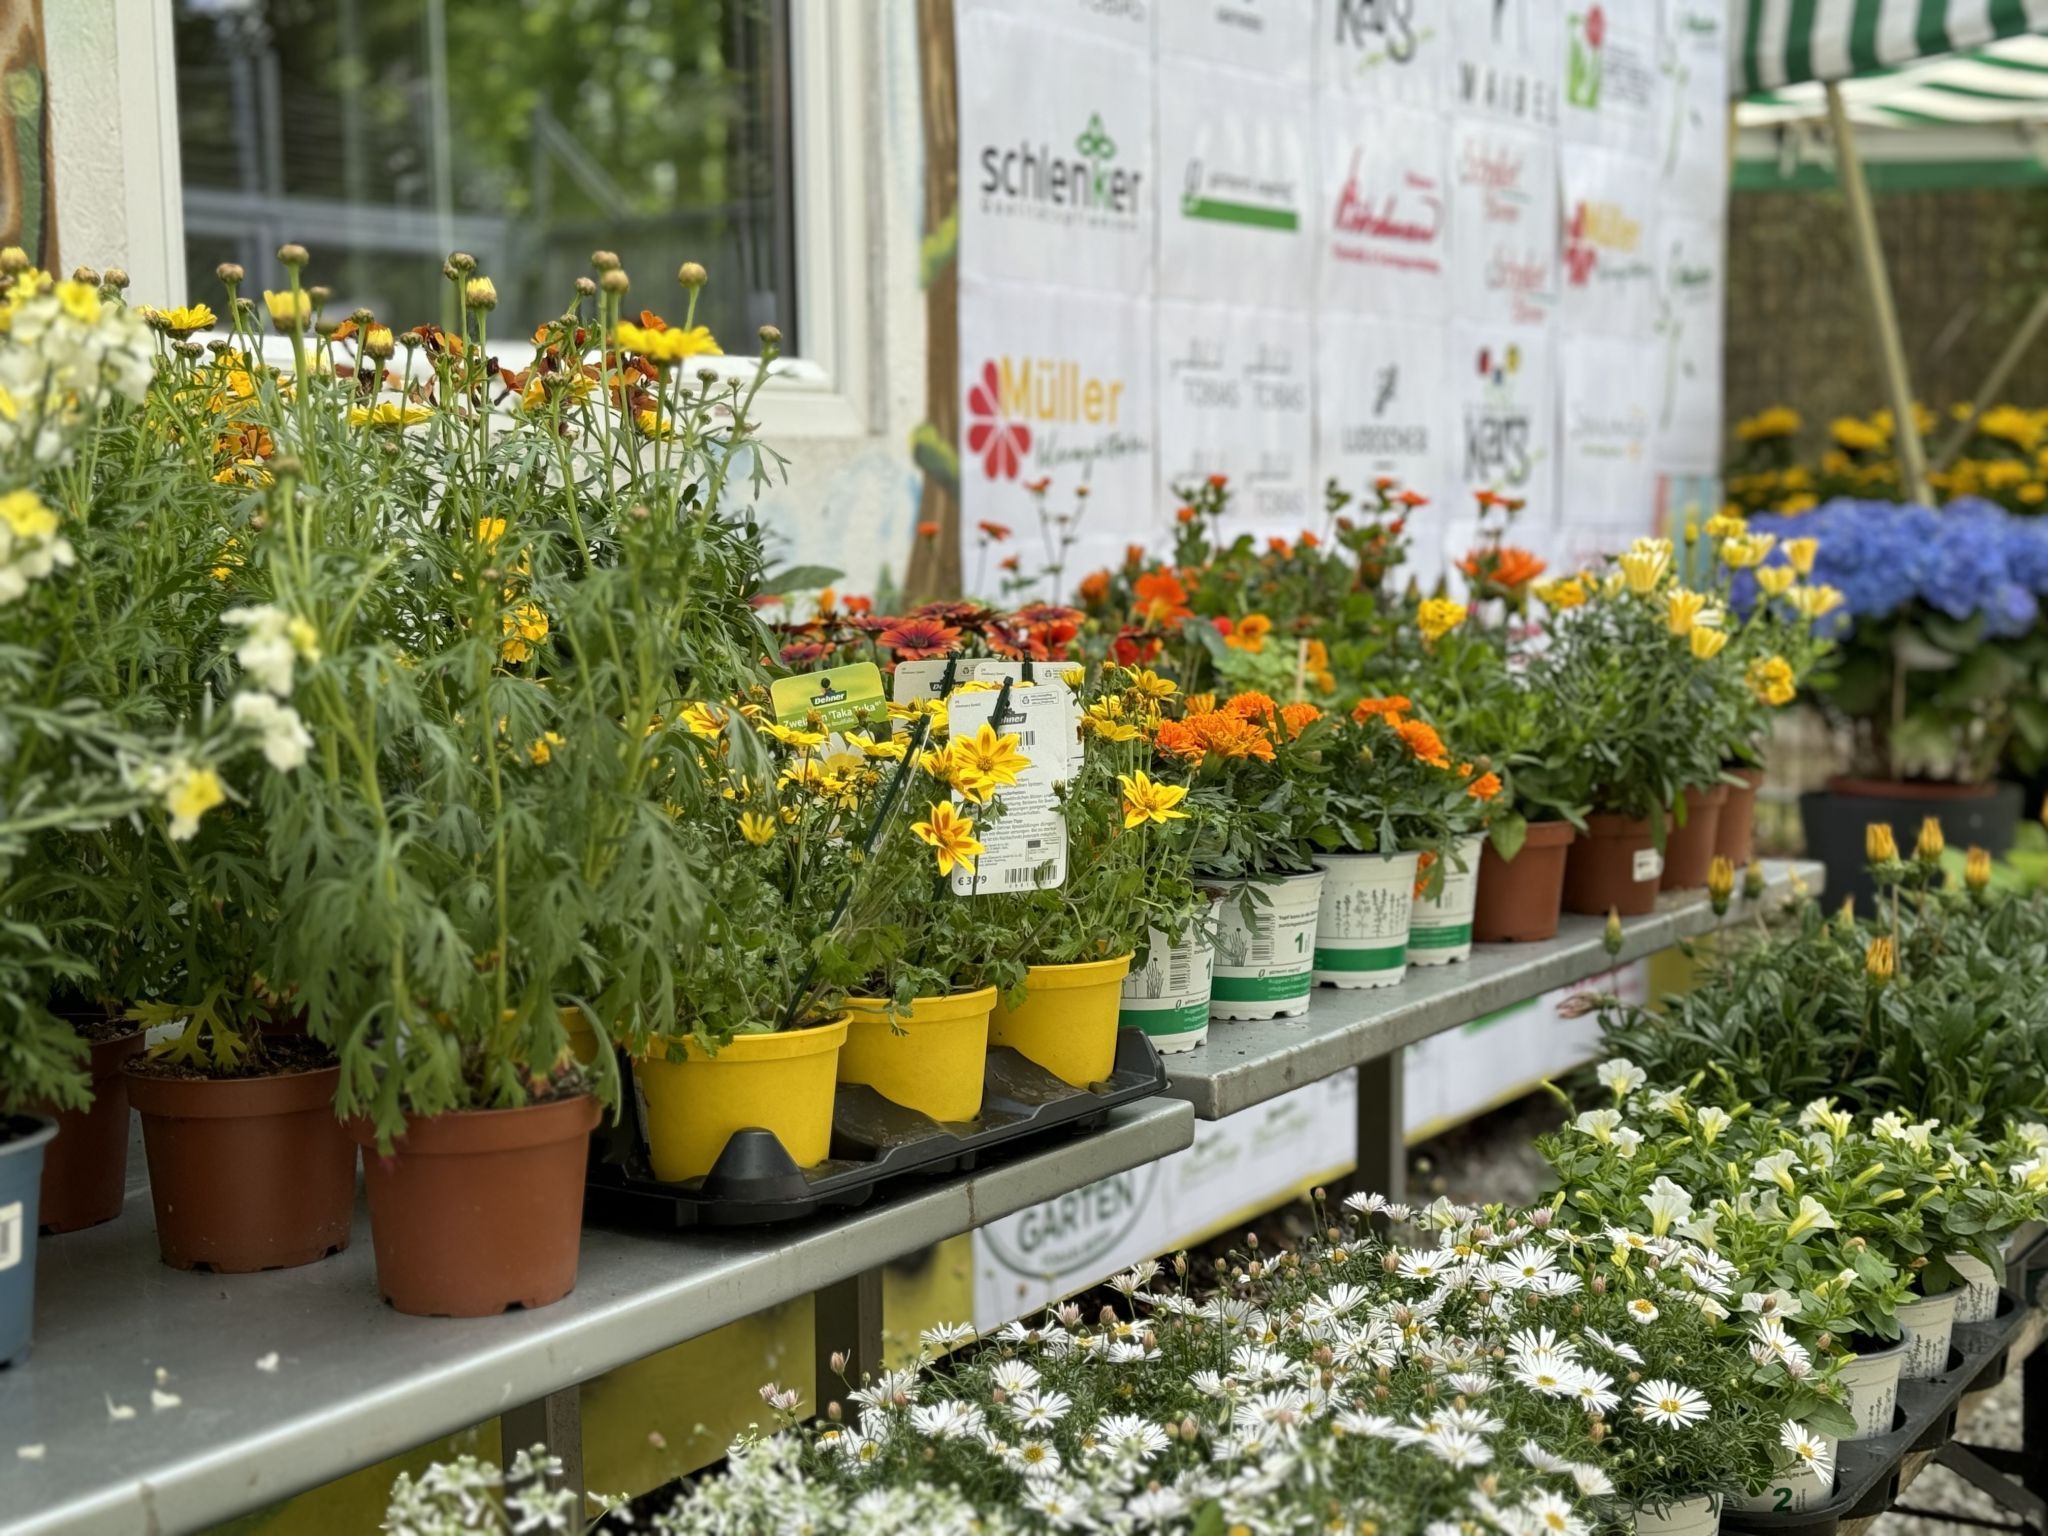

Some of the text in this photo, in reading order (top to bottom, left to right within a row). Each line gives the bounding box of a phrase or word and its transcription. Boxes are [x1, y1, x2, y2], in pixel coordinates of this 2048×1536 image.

[981, 139, 1142, 214] schlenker
[1000, 356, 1125, 424] Müller
[814, 693, 845, 705] Dehner
[1295, 932, 1304, 953] 1
[1205, 958, 1212, 980] 1
[1017, 1174, 1133, 1253] GARTEN
[1773, 1487, 1793, 1512] 2
